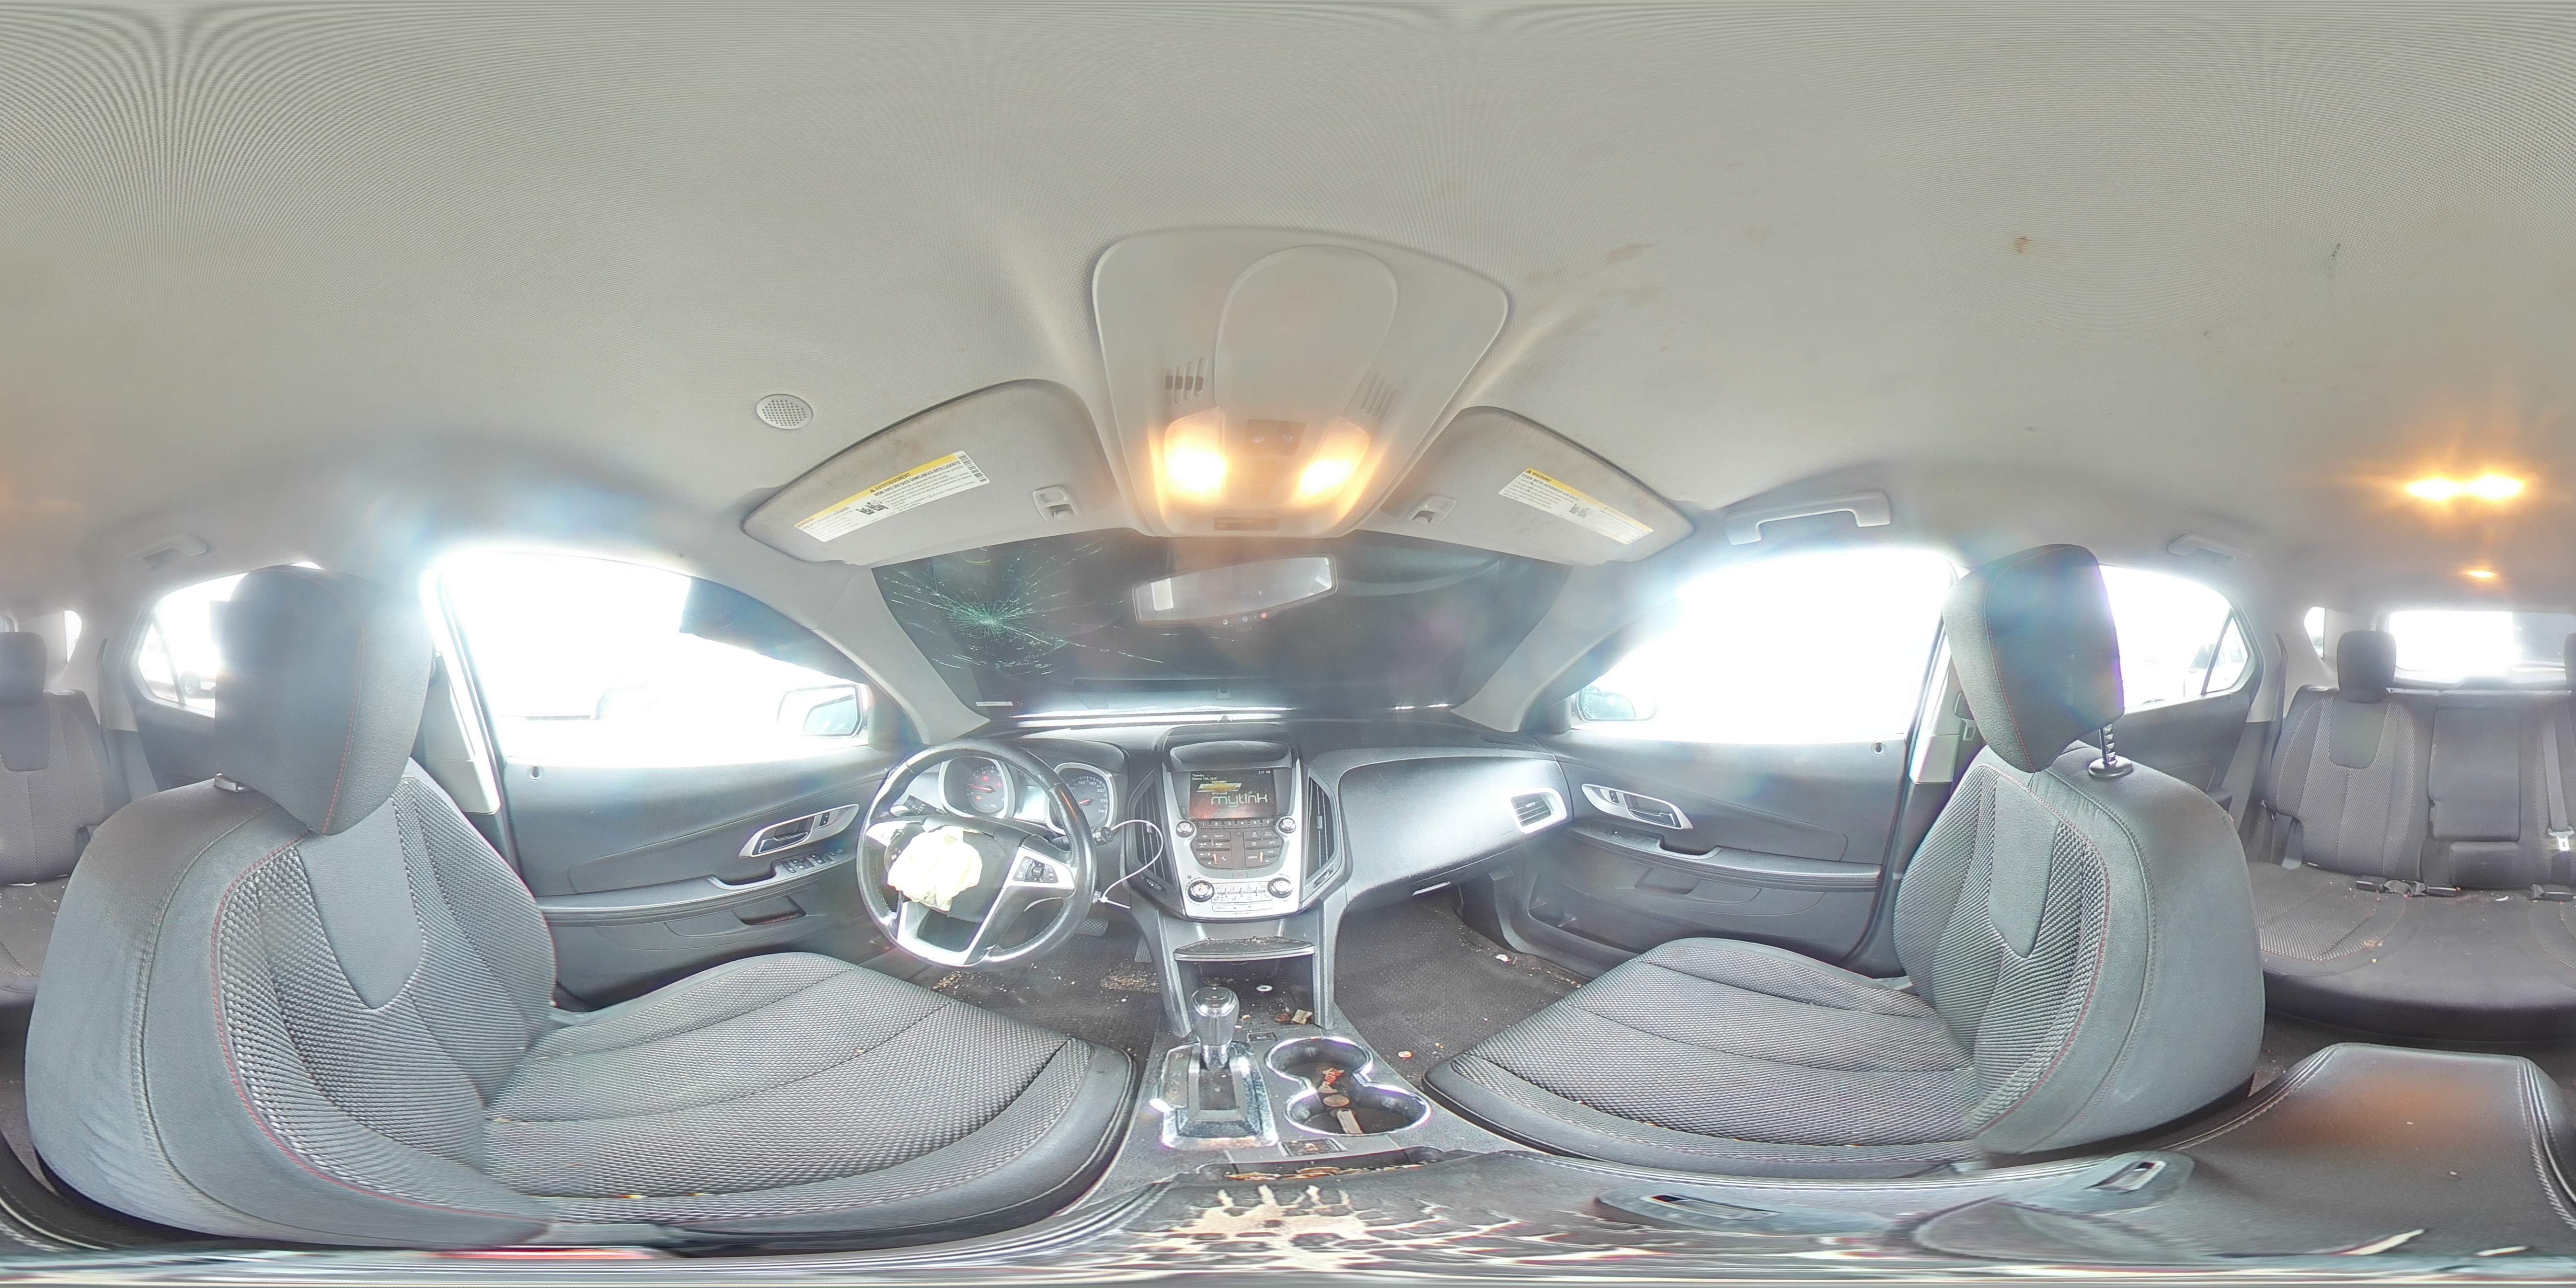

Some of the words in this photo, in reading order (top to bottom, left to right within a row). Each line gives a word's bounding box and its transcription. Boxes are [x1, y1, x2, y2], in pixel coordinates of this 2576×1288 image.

[932, 460, 961, 473] INTELLIGENTS
[875, 472, 911, 490] AVERTISSEMENT
[1532, 472, 1552, 483] WARNING
